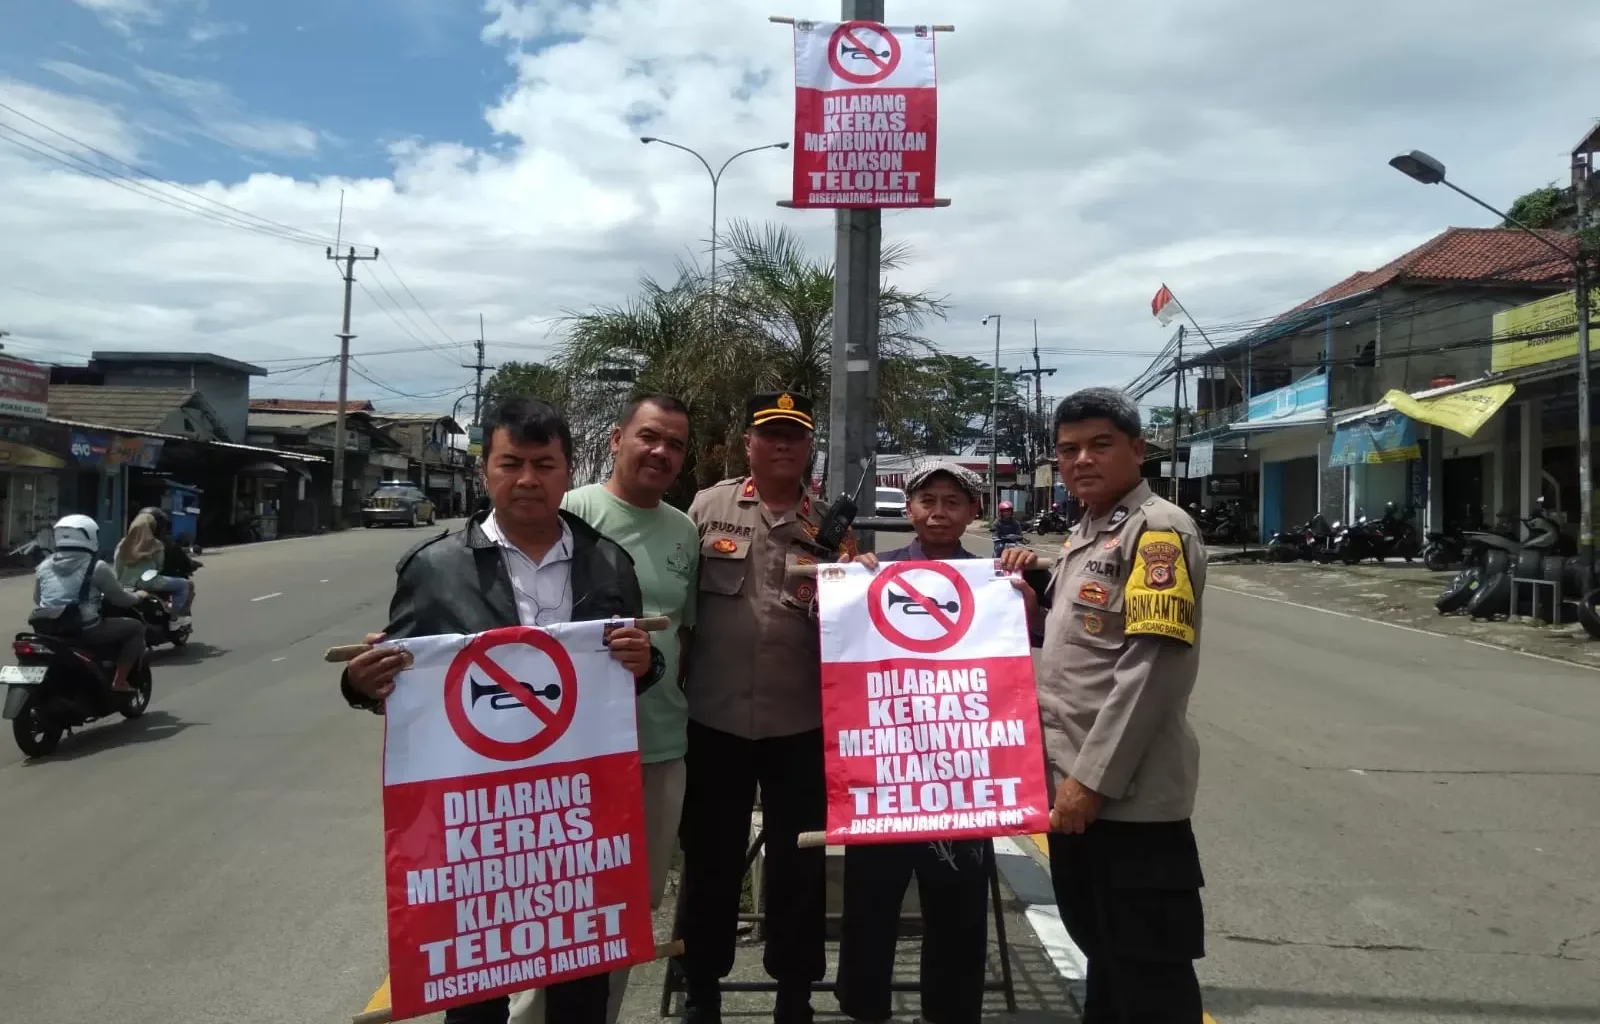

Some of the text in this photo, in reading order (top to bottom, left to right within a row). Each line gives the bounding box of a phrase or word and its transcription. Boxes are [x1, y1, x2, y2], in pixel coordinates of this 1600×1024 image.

[823, 94, 907, 114] DILARANG
[823, 112, 906, 133] KERAS
[804, 132, 927, 152] MEMBUNYIKAN
[827, 151, 903, 171] KLAKSON
[808, 171, 921, 191] TELOLET
[808, 192, 873, 204] DISEPANJANG
[875, 192, 903, 204] JALUR
[710, 520, 757, 537] SUDAR
[1083, 560, 1121, 577] POLRI
[1126, 593, 1196, 627] ABINKAMTIBM
[866, 667, 988, 699] DILARANG
[867, 693, 990, 727] KERAS
[838, 719, 1026, 757] MEMBUNYIKAN
[875, 749, 990, 784] KLAKSON
[443, 772, 592, 827] DILARANG
[848, 777, 1023, 816] TELOLET
[445, 807, 594, 863] KERAS
[850, 813, 950, 835] DISEPANJANG
[951, 809, 997, 830] JALUR
[406, 833, 632, 906] MEMBUNYIKAN
[455, 876, 595, 934] KLAKSON
[419, 902, 628, 977] TELOLET
[423, 938, 628, 1004] DISEPANJANG JALUR INI
